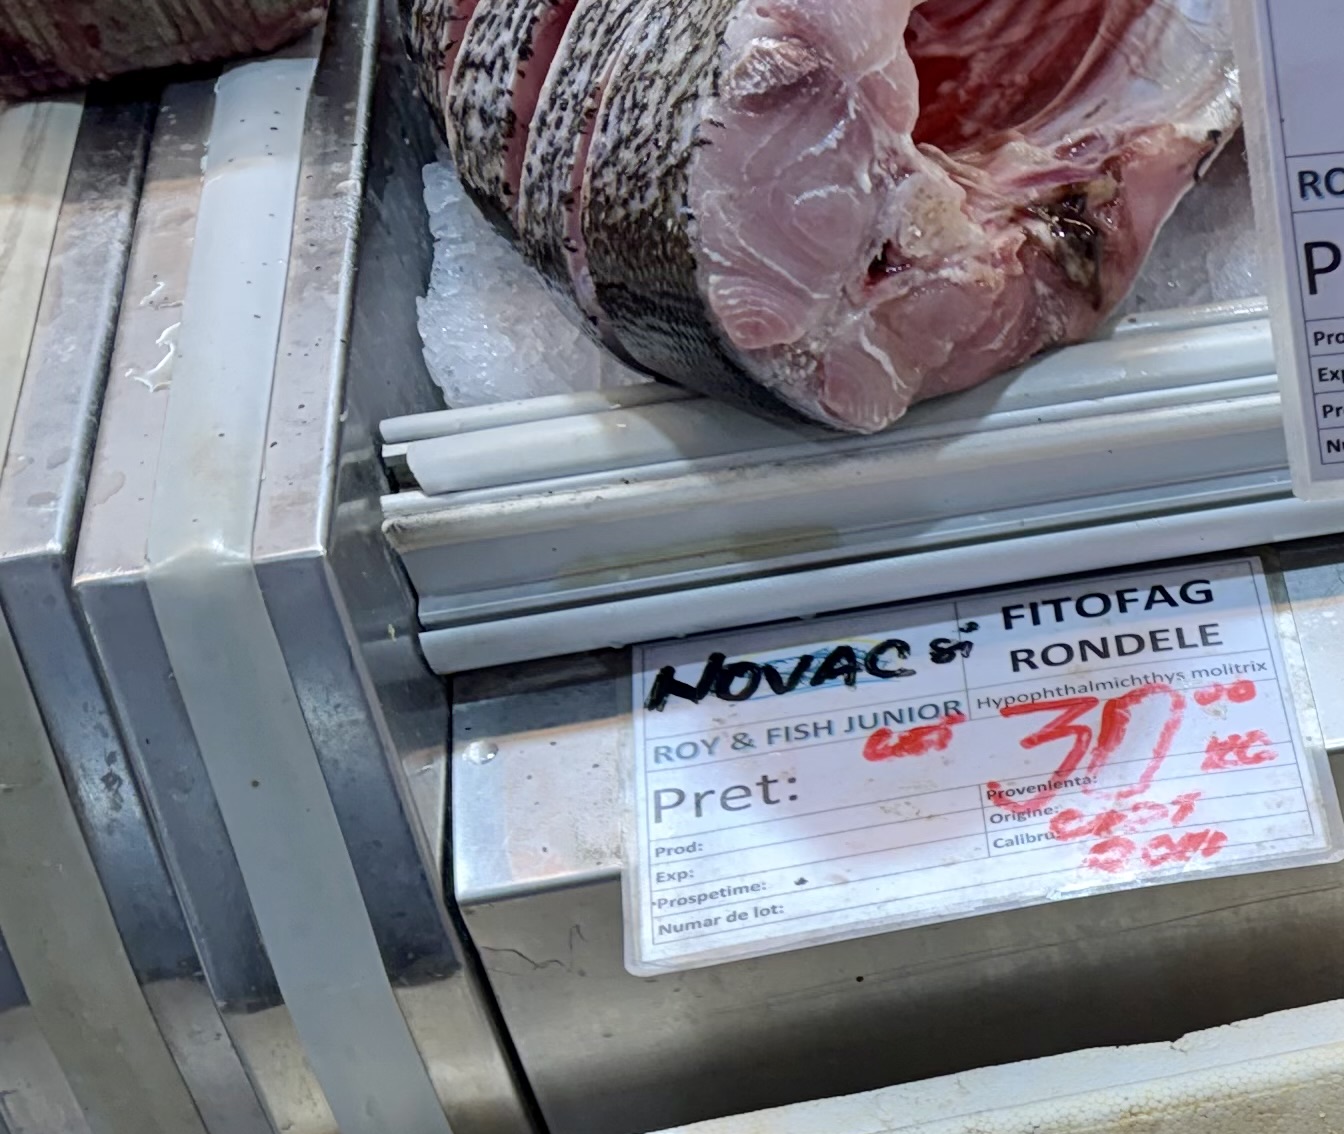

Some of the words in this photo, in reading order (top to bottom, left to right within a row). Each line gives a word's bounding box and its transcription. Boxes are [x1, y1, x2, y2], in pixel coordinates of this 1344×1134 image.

[1001, 578, 1215, 631] FITOFAG
[1009, 623, 1224, 673] RONDELE
[643, 638, 917, 713] NOVAC
[976, 668, 1186, 712] Hypophthalmichthys
[1191, 659, 1268, 680] molitrix
[653, 735, 720, 765] ROY
[730, 731, 757, 751] &
[766, 718, 833, 746] FISH
[843, 699, 963, 734] JUNIOR
[653, 774, 799, 824] Pret:
[986, 774, 1098, 800] Provenienta:
[989, 804, 1060, 826] Origine:
[654, 841, 704, 858] Prod:
[655, 868, 695, 884] Exp:
[656, 881, 767, 910] Prospetime:
[658, 916, 722, 936] Numar
[726, 910, 749, 924] de
[754, 904, 785, 919] lot:
